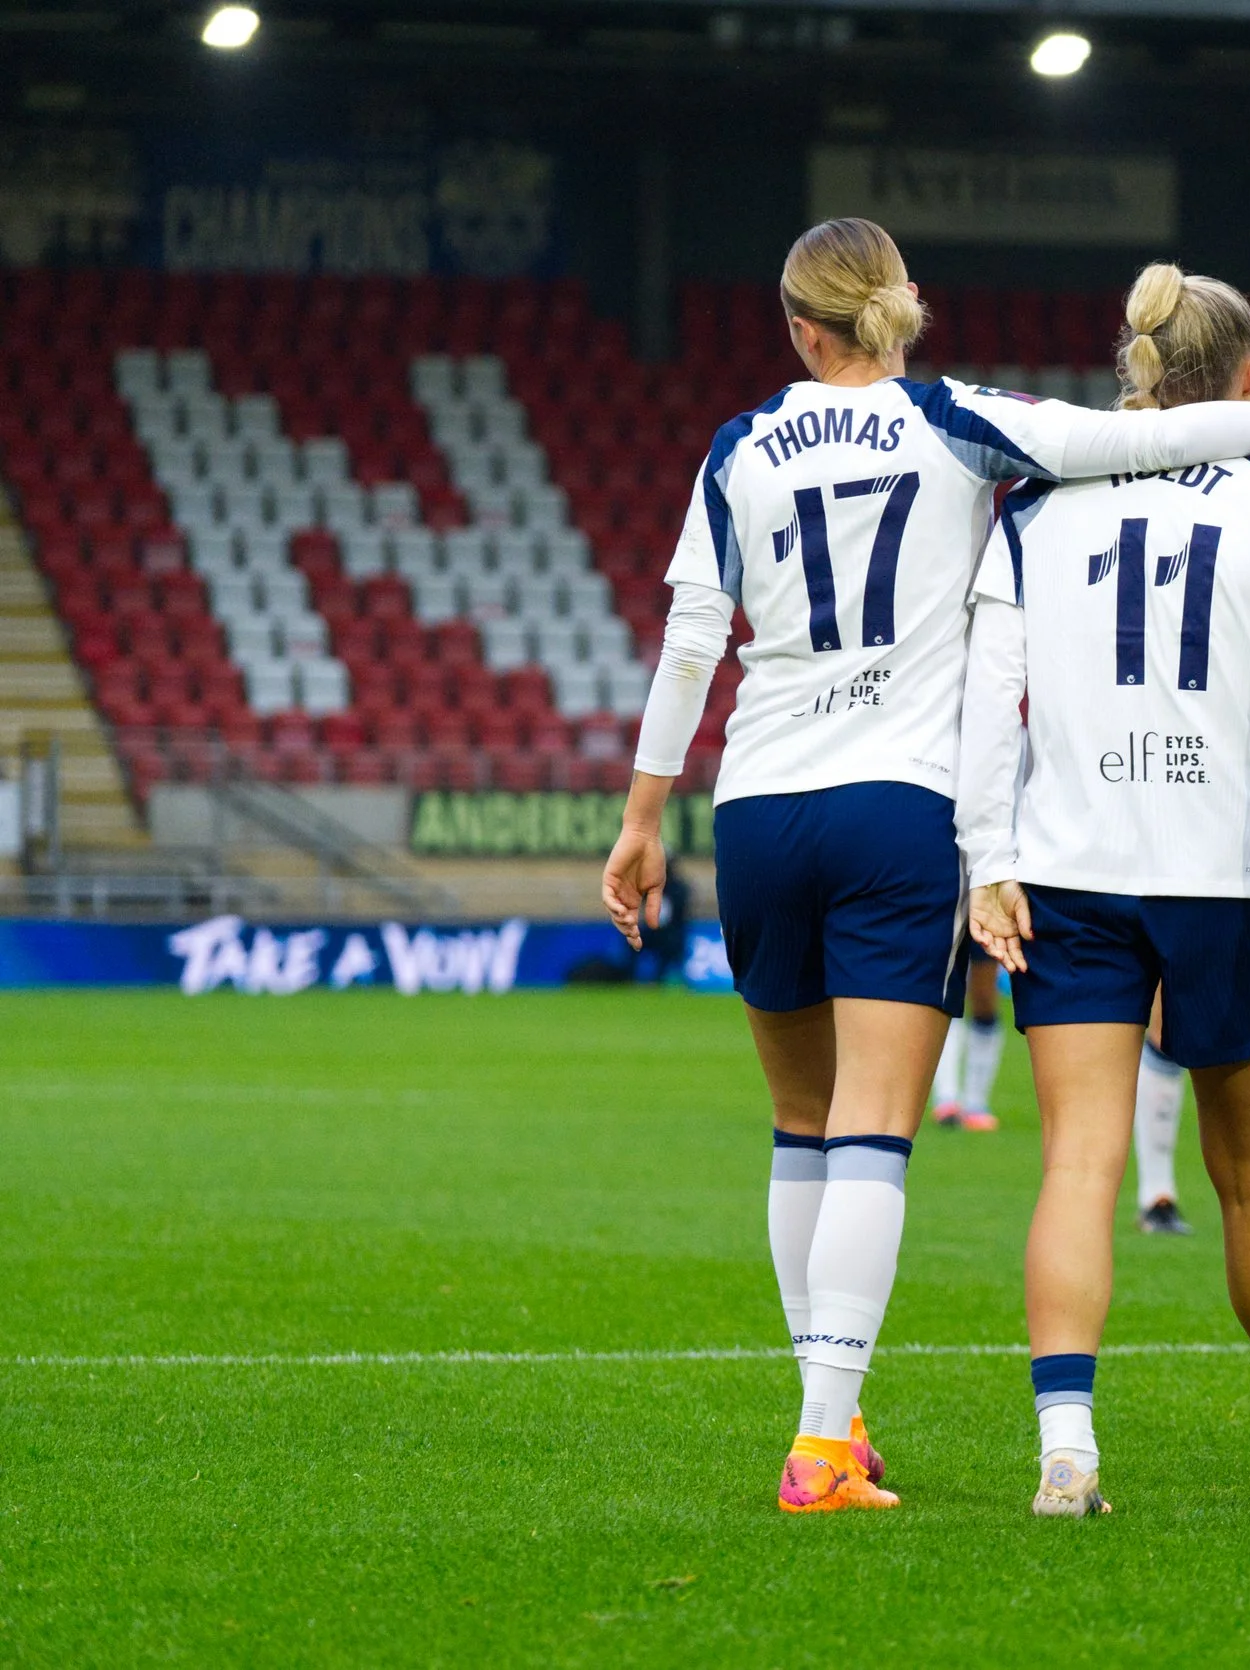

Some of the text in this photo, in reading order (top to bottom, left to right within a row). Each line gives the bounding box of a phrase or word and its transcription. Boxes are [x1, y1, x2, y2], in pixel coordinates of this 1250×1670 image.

[754, 407, 905, 468] THOMAS
[771, 470, 921, 653] 17
[1088, 517, 1222, 691] 11
[1165, 735, 1210, 750] EYES.
[1165, 752, 1206, 767] LIPS.
[1165, 769, 1211, 784] FACE.
[168, 914, 326, 996] TAKE
[330, 933, 376, 991] A
